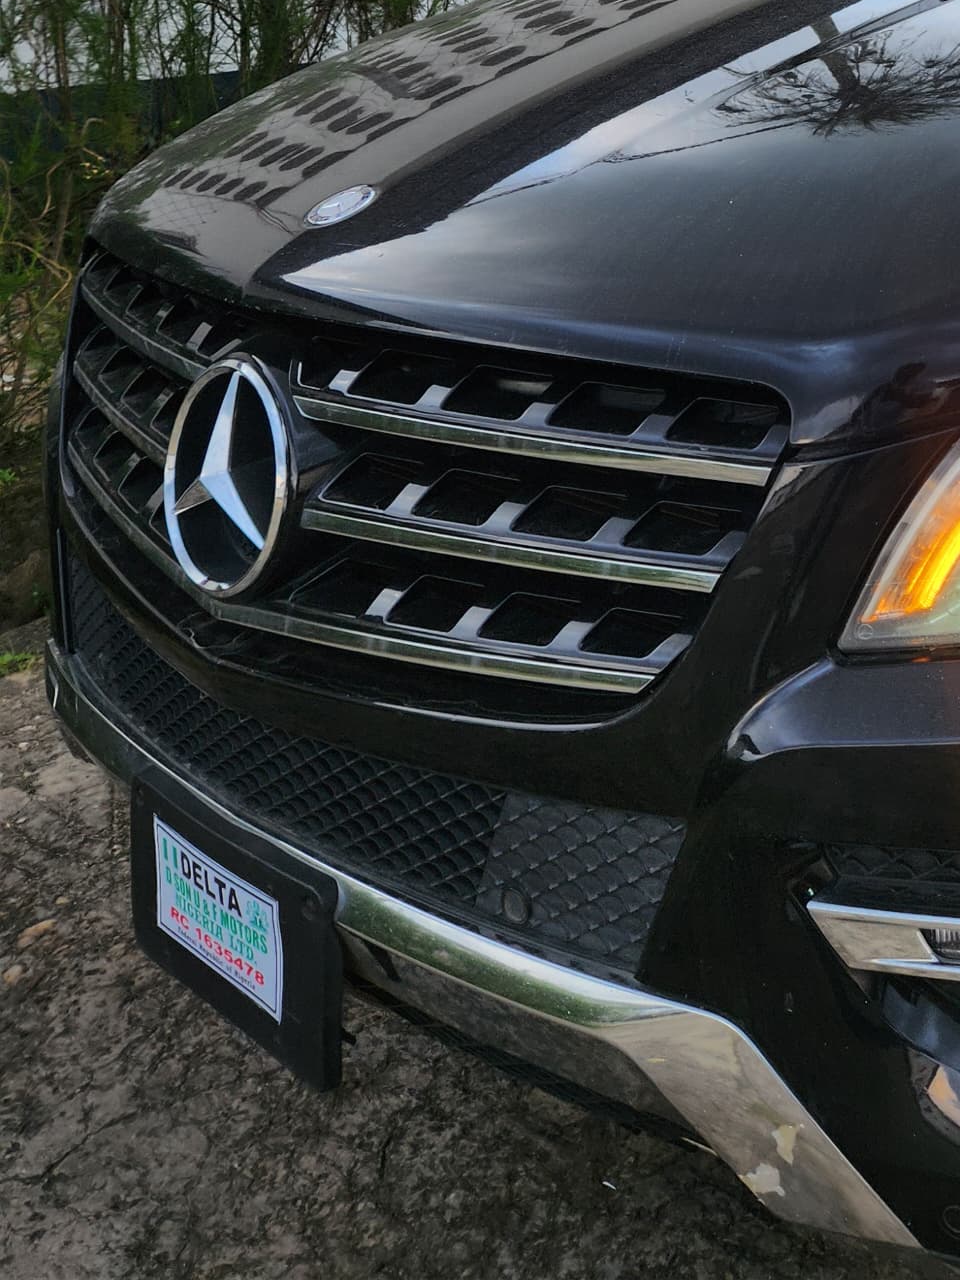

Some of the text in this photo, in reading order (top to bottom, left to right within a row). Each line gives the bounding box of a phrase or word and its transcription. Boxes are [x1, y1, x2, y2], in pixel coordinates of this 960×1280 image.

[181, 851, 242, 917] DELTA
[170, 906, 265, 987] RC 1635478
[175, 892, 223, 943] NIGERIA
[220, 909, 268, 955] MOTORS
